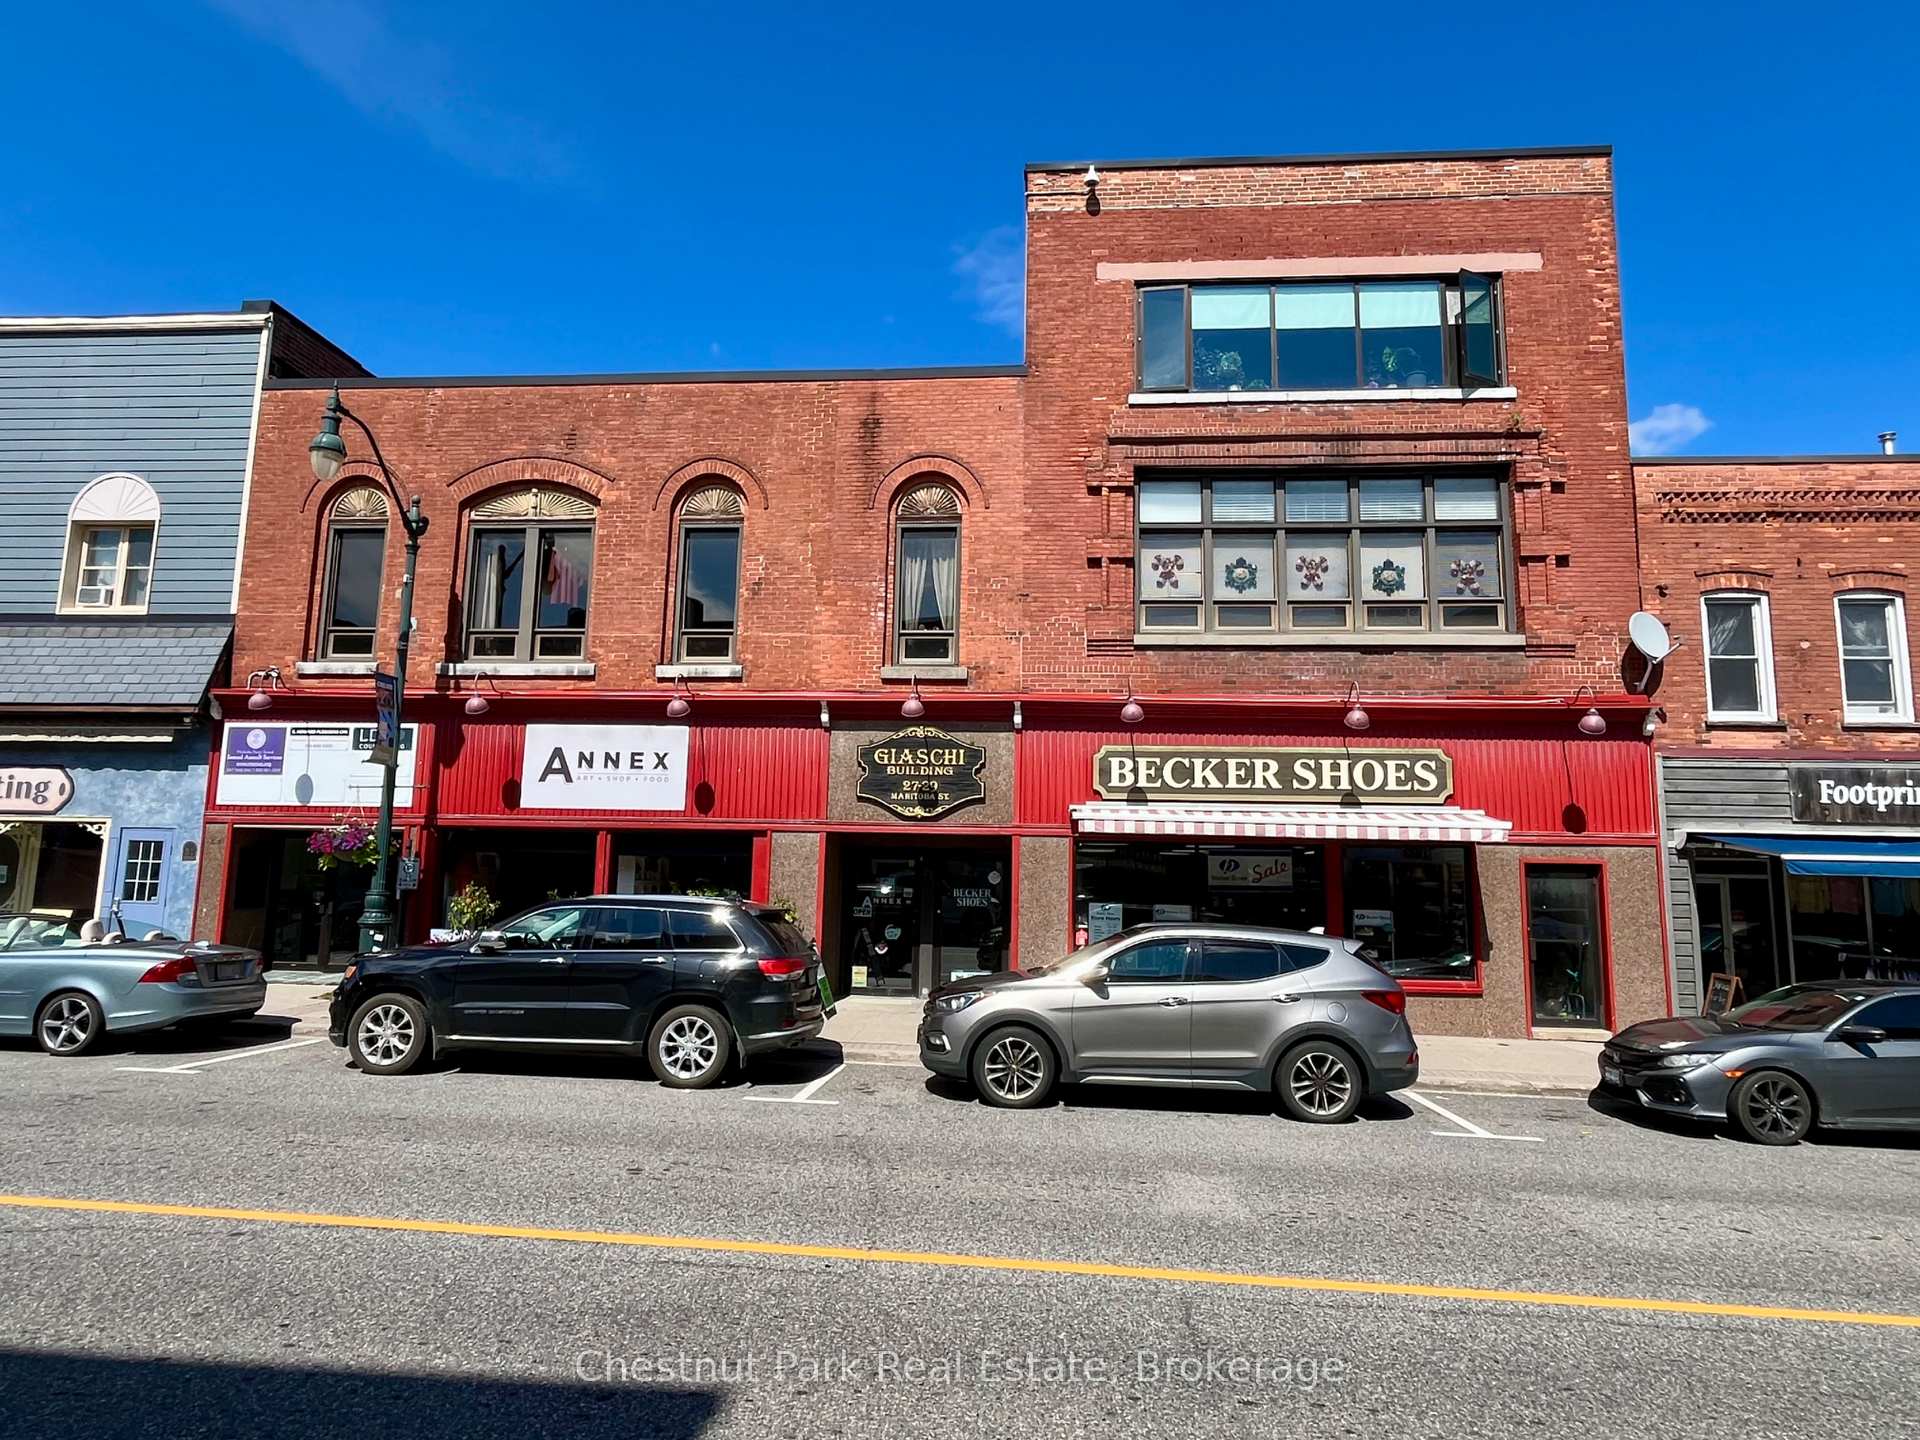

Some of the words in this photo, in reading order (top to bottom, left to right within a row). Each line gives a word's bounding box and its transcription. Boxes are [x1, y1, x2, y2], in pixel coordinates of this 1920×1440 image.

[873, 748, 966, 765] GIASCHI
[537, 747, 670, 783] ANNEX
[886, 766, 954, 775] BUILDING
[606, 775, 632, 783] SHOP
[1108, 757, 1283, 789] BECKER
[1292, 758, 1439, 791] SHOES
[902, 780, 939, 791] 27-29
[1251, 859, 1289, 884] Sale
[953, 888, 991, 897] BECKER
[956, 897, 988, 907] SHOES
